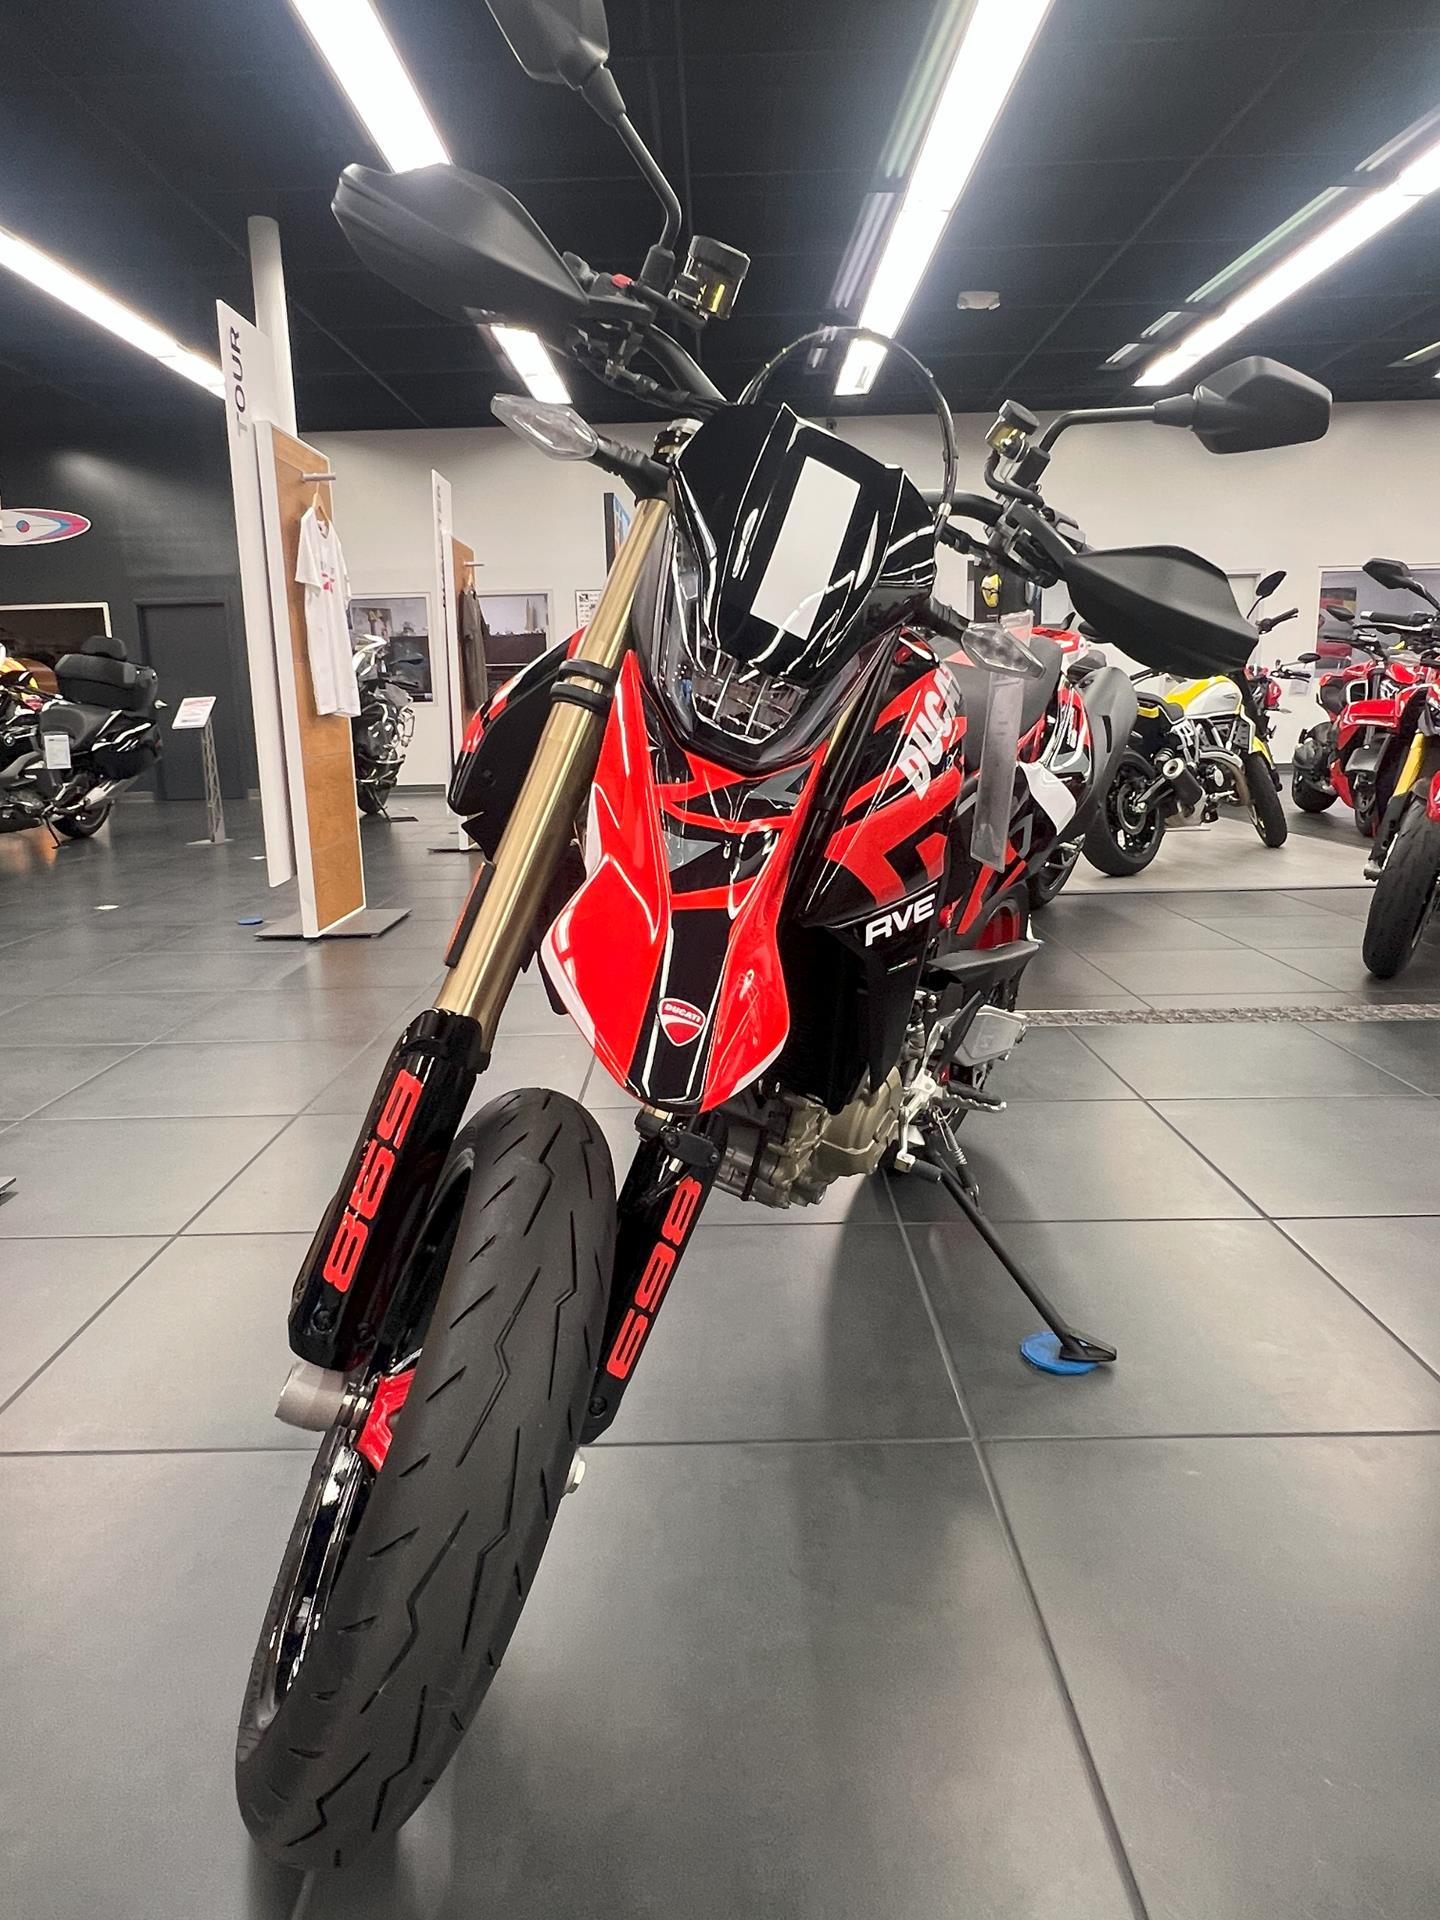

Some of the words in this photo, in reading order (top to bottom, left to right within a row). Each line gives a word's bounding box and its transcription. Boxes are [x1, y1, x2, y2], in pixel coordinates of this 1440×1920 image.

[230, 326, 248, 437] TOUR
[865, 893, 936, 947] RVE
[664, 1003, 702, 1023] DUCATI
[606, 1177, 702, 1380] 698
